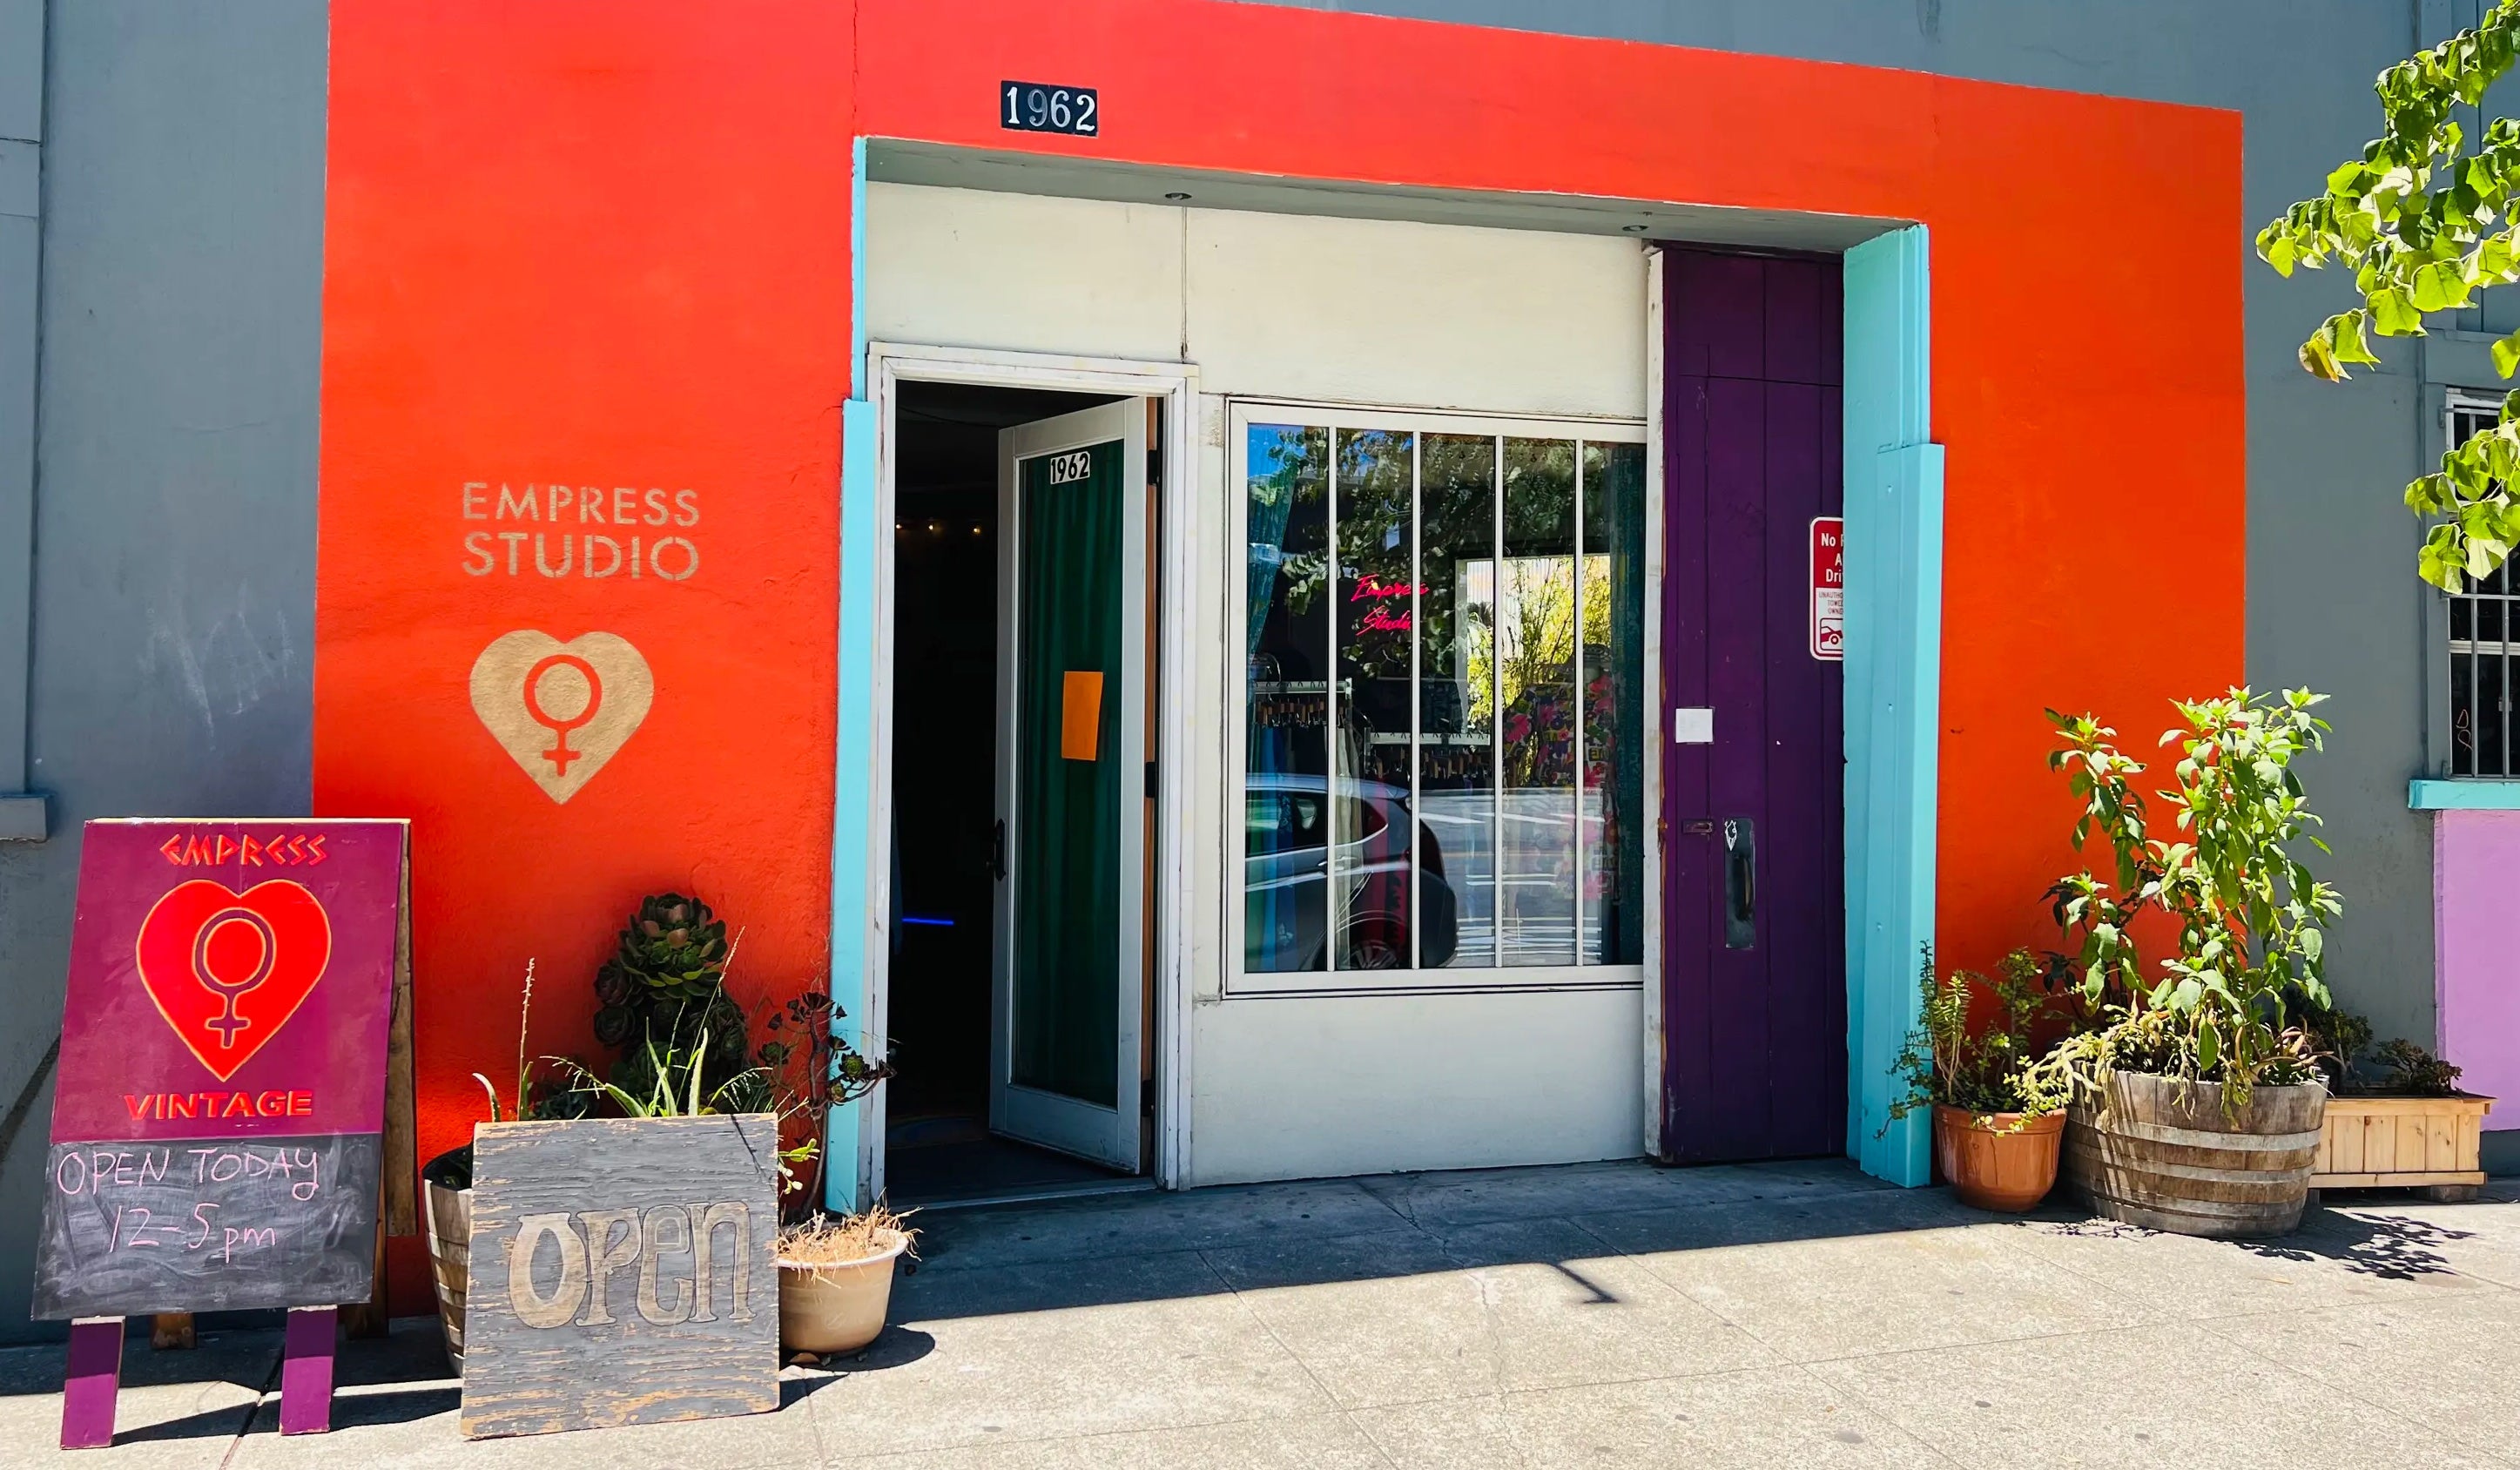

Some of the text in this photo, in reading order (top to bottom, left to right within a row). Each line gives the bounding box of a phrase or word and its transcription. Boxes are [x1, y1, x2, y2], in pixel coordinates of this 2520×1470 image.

[1007, 86, 1095, 131] 1962
[1051, 453, 1088, 483] 1962
[462, 482, 700, 527] EMPRESS
[462, 532, 699, 580] STUDIO
[1821, 533, 1836, 547] No
[160, 833, 327, 866] EMPRESS
[124, 1089, 313, 1121] VINTAGE
[57, 1147, 319, 1201] OPEN TODAY
